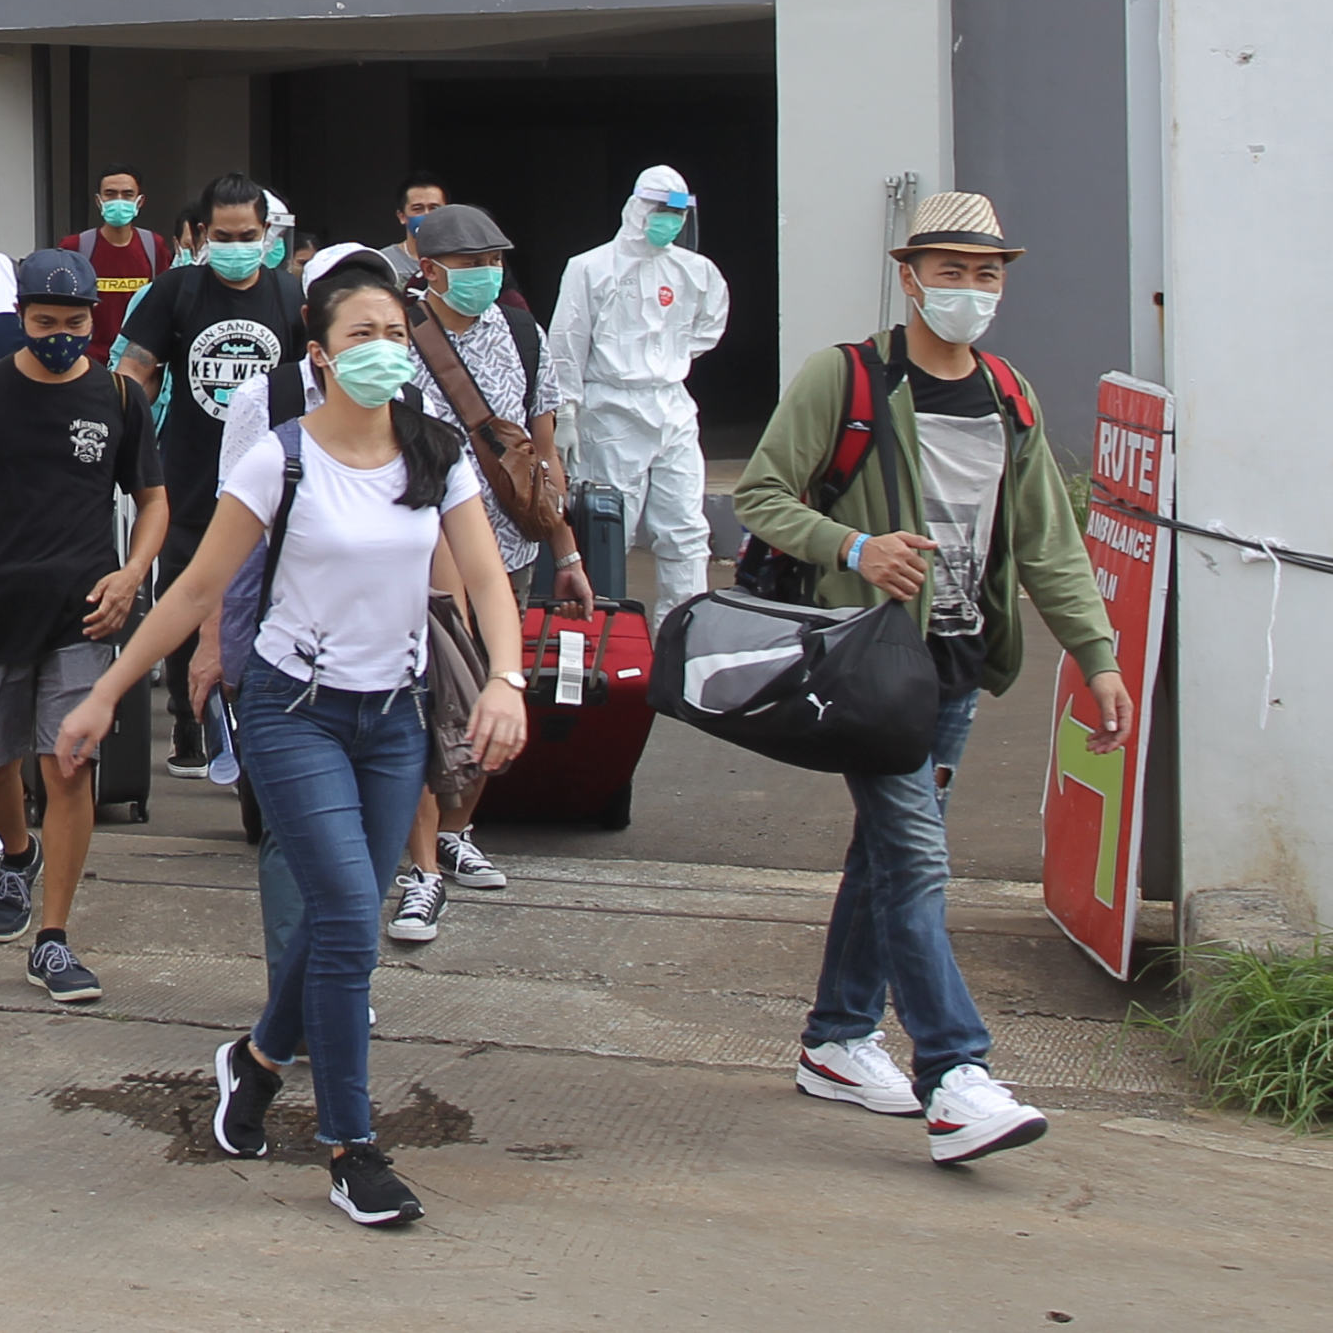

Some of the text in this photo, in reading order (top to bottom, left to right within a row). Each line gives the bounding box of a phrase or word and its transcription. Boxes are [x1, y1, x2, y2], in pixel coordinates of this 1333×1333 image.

[191, 360, 222, 379] KEY
[1098, 421, 1155, 495] RUTE
[1087, 510, 1152, 563] AMBULANCE
